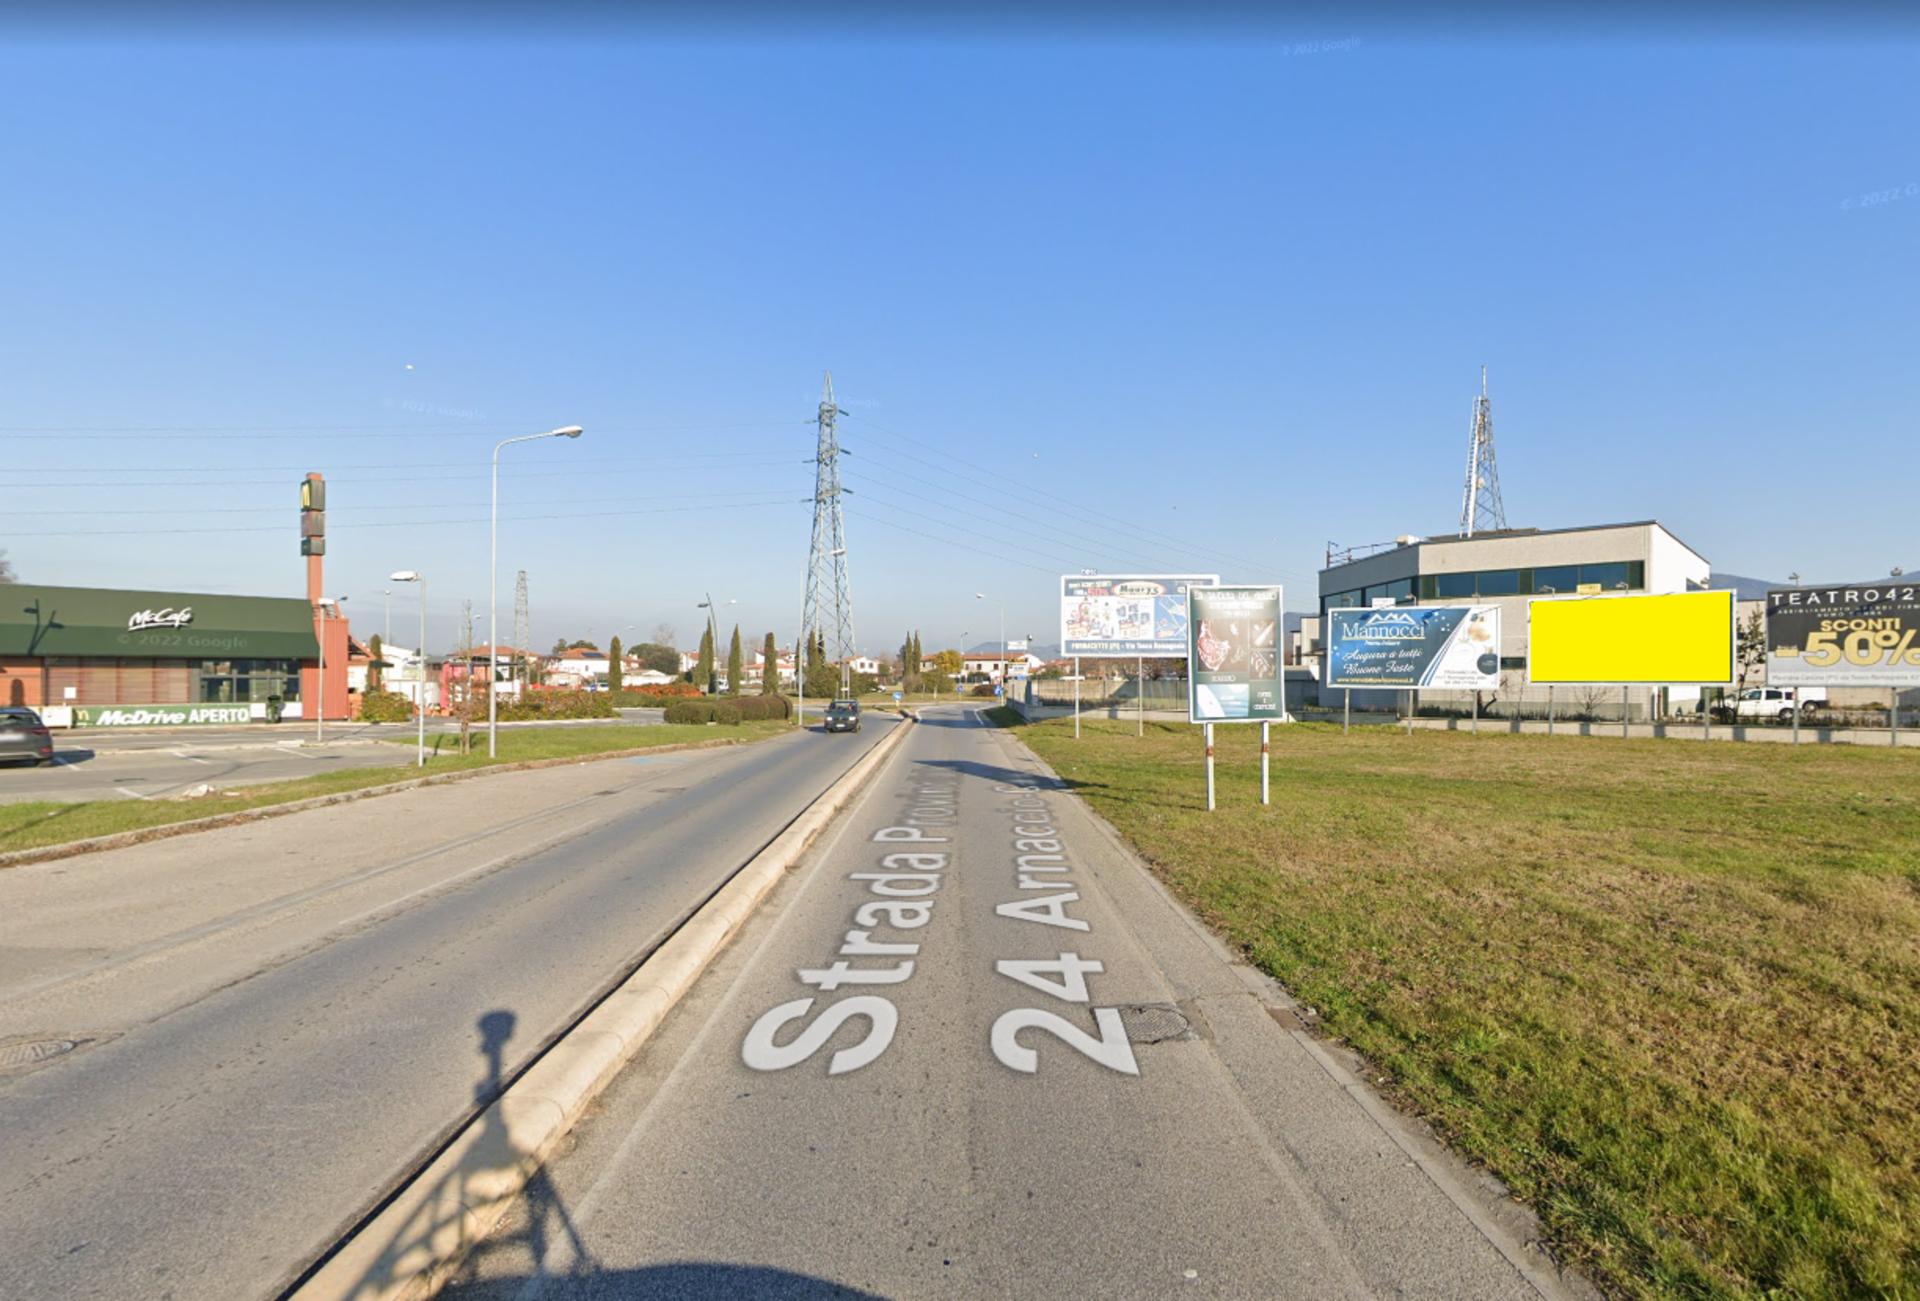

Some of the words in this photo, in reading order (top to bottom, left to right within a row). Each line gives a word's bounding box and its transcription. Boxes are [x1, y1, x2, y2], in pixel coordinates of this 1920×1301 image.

[1771, 588, 1918, 606] TEATRO42
[1342, 622, 1425, 638] Mannocci
[1820, 617, 1900, 632] SCONTI
[96, 709, 187, 725] McDrive
[188, 708, 249, 723] APERTO
